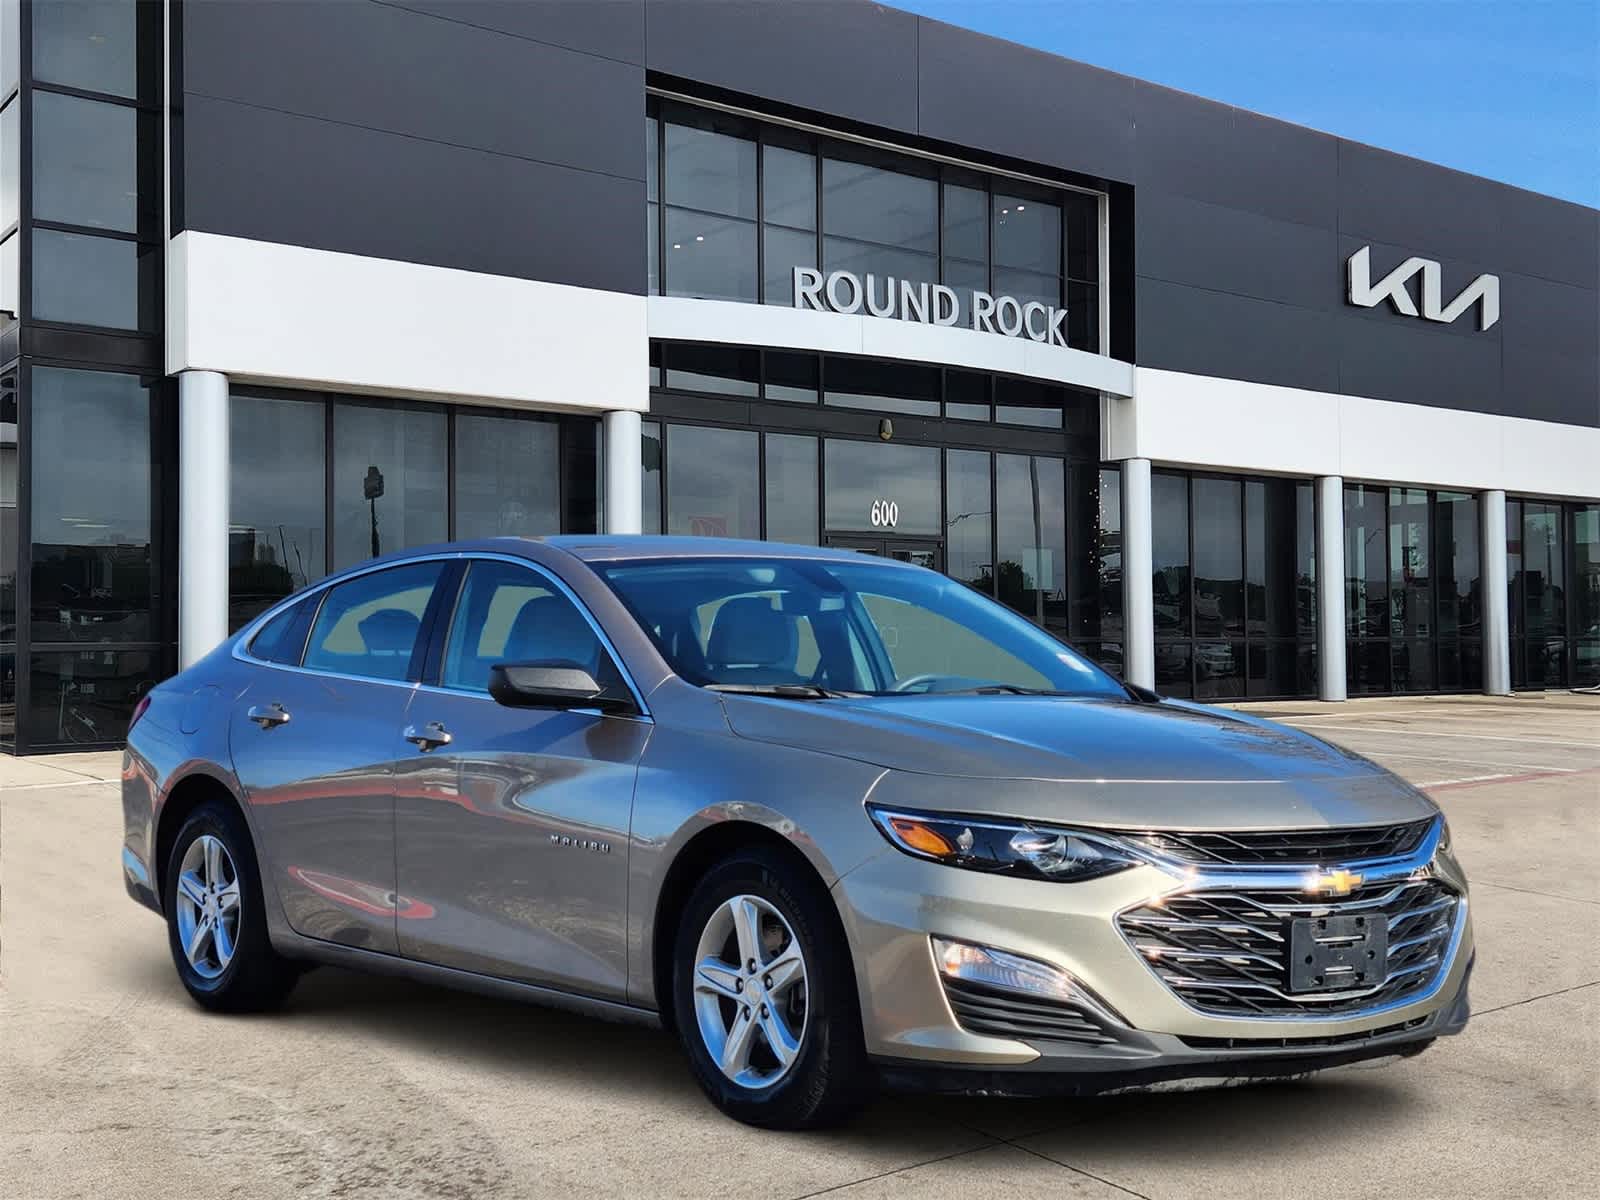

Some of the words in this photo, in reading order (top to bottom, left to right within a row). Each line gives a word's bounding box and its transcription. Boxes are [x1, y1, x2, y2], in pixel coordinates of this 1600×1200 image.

[792, 266, 959, 327] ROUND
[971, 290, 1069, 347] ROCK
[1348, 245, 1500, 331] KIA
[871, 500, 898, 527] 600
[551, 834, 610, 853] MALIBU
